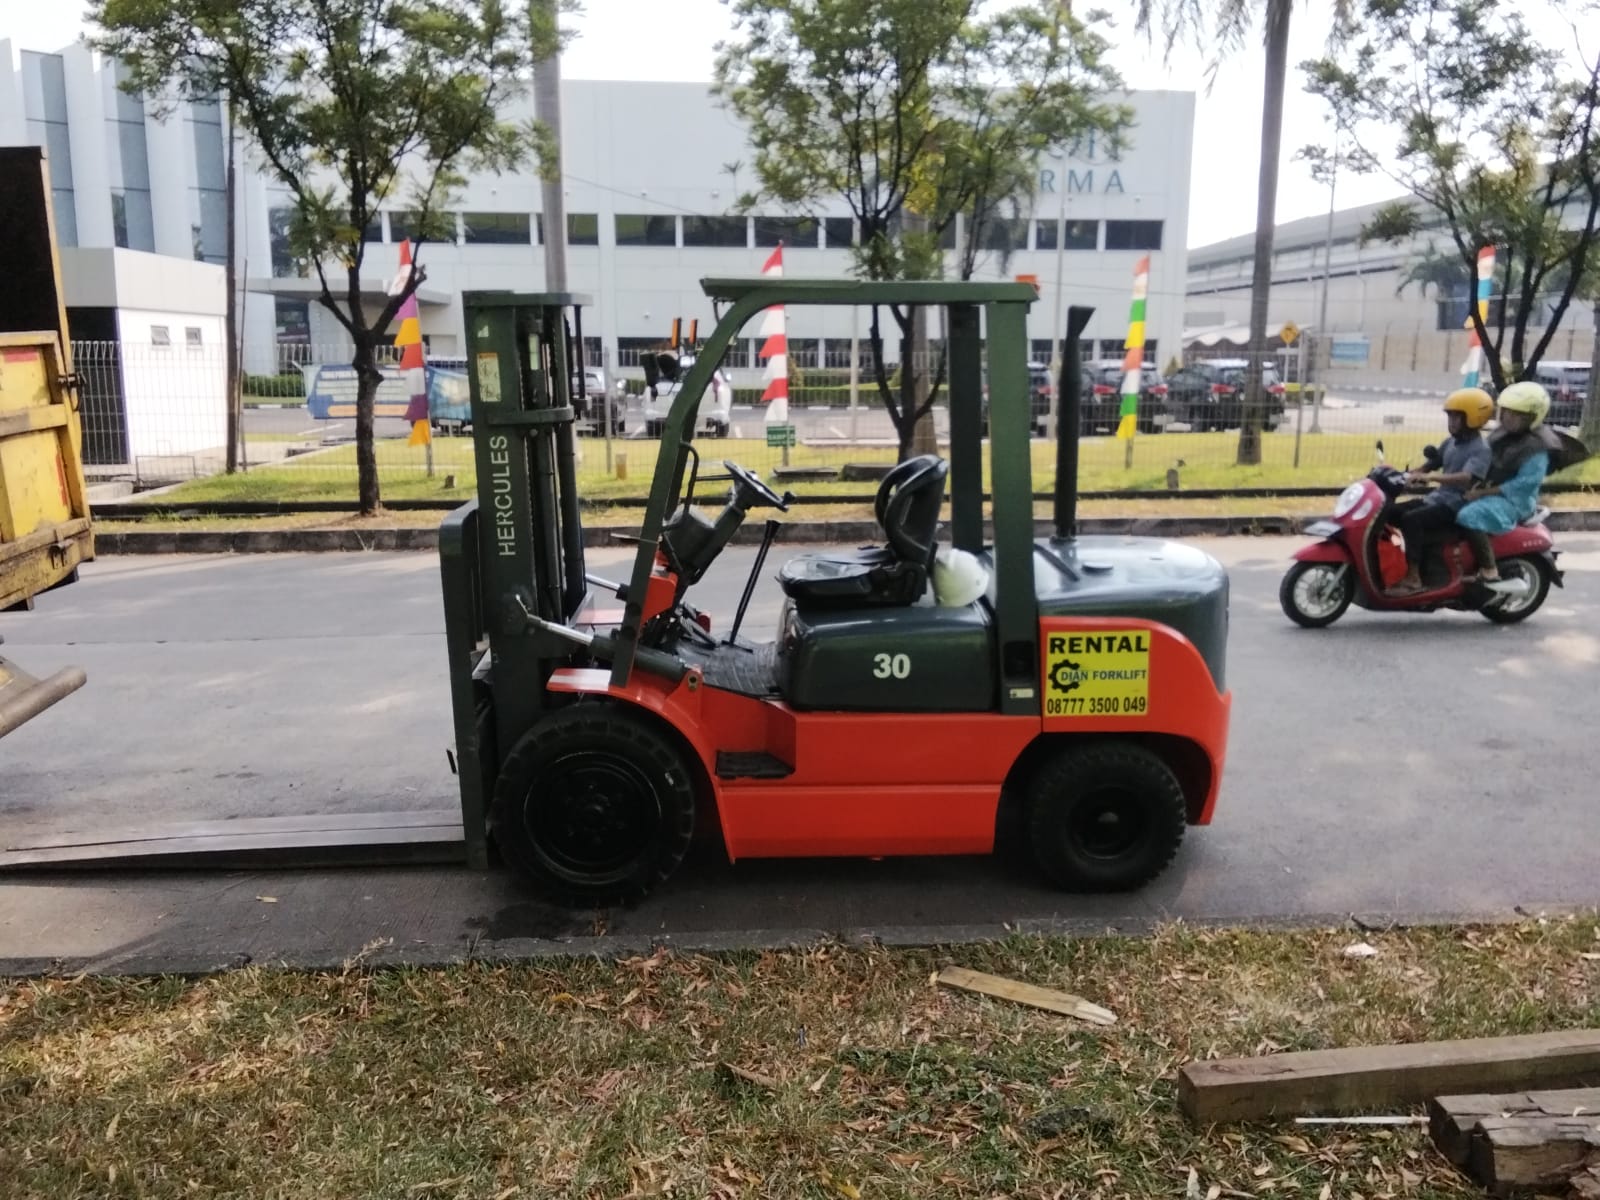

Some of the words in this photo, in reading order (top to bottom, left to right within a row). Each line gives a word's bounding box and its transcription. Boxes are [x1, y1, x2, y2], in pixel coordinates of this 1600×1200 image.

[1040, 169, 1125, 193] RMA
[489, 435, 516, 556] HERCULES
[1049, 636, 1148, 654] RENTAL
[873, 653, 911, 679] 30
[1061, 671, 1088, 681] DIAN
[1093, 670, 1146, 680] FORKLIFT
[1047, 698, 1085, 714] 08777
[1089, 697, 1119, 713] 3500
[1123, 697, 1146, 712] 049
